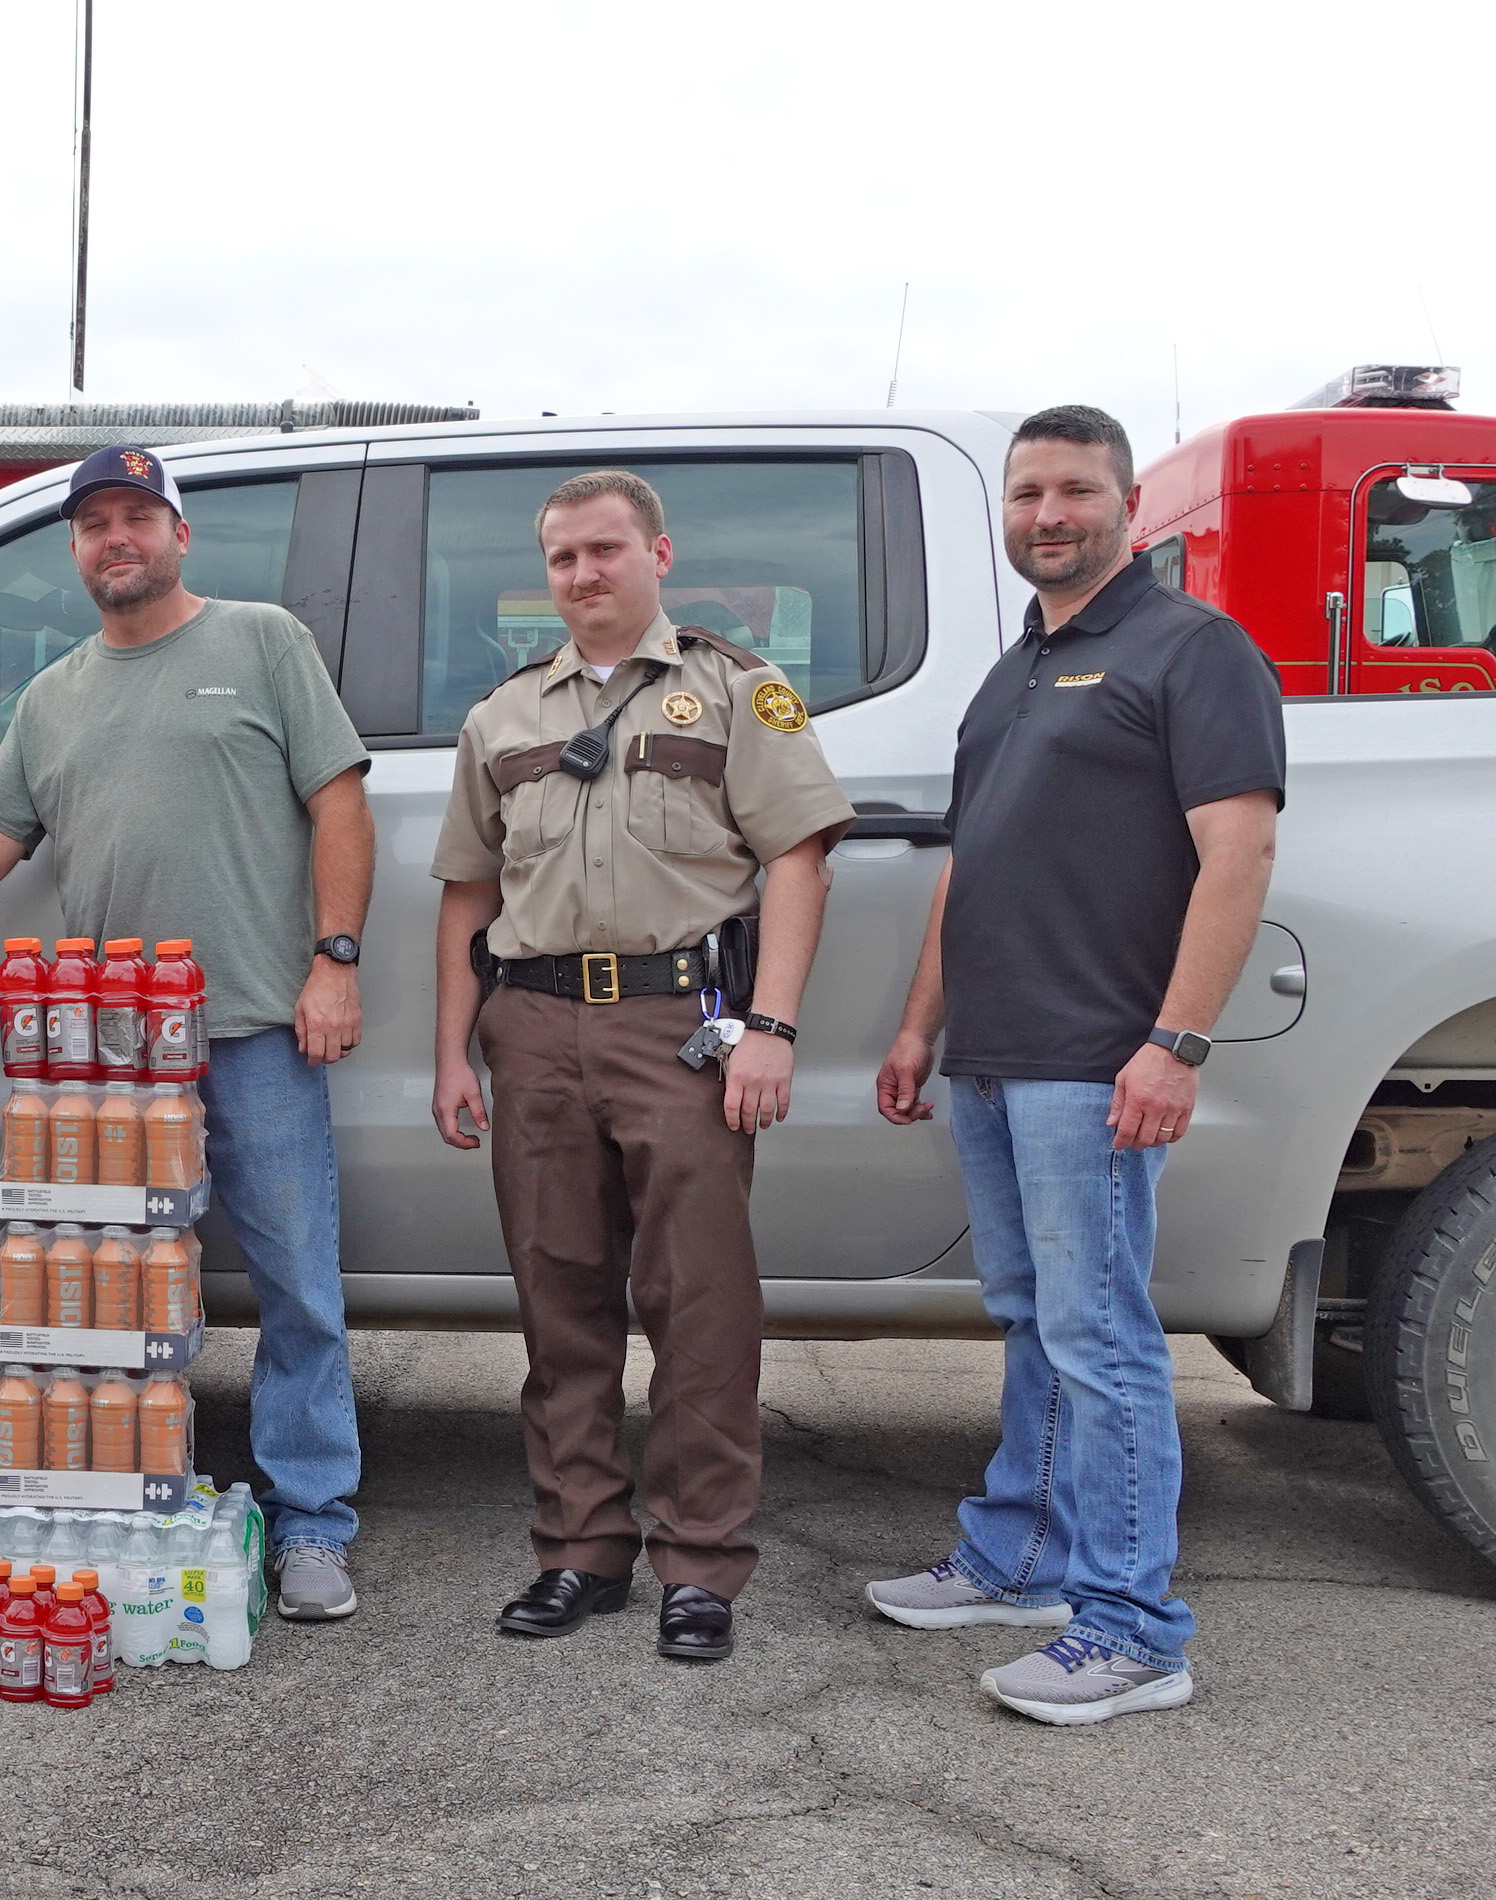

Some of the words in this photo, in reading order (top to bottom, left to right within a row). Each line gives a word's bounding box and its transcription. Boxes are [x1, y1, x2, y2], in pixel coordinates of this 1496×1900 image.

[1057, 672, 1105, 682] RISON
[197, 686, 237, 696] MAGELLAN
[14, 1008, 38, 1037] G
[46, 1009, 61, 1039] G
[162, 1015, 186, 1044] G
[183, 1580, 204, 1593] 40
[122, 1598, 174, 1615] water
[0, 1641, 16, 1663] G
[93, 1635, 108, 1657] G
